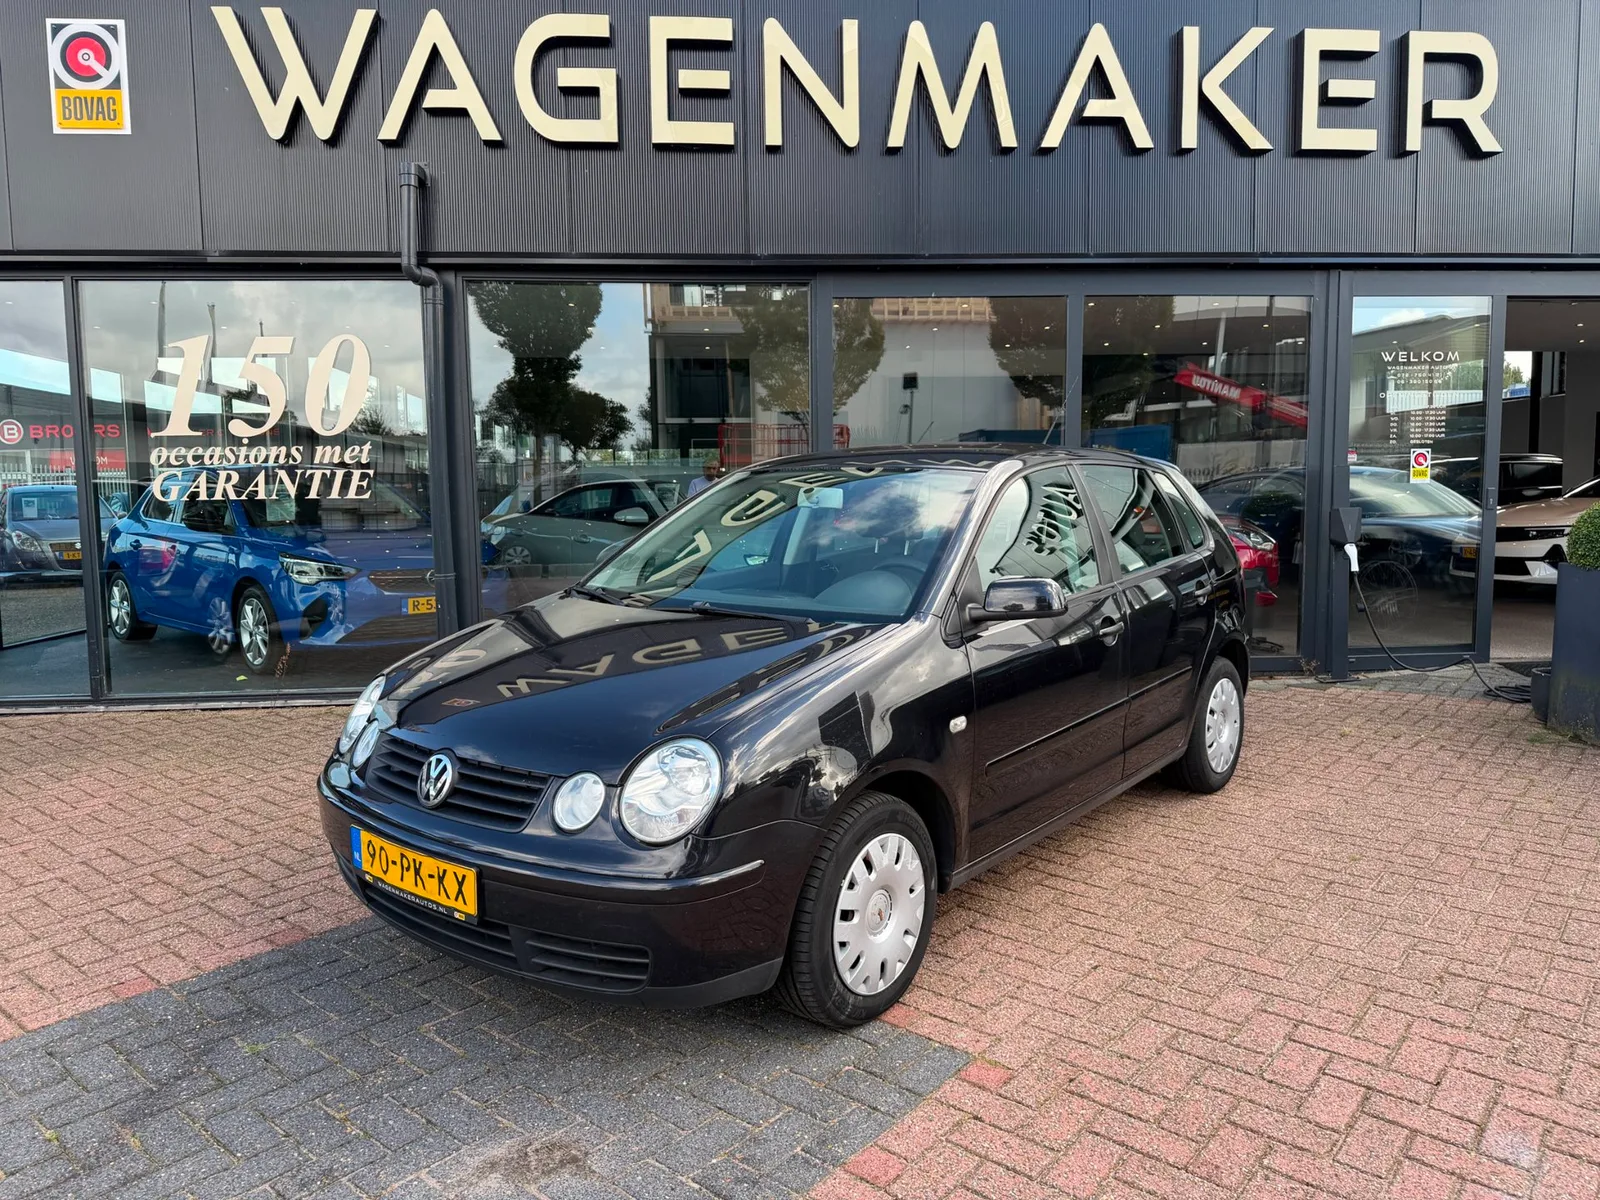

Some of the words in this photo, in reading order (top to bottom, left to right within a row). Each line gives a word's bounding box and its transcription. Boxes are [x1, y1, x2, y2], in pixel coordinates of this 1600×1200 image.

[211, 5, 1503, 154] WAGENMAKER
[61, 95, 118, 121] BOVAG
[1381, 351, 1460, 362] WELKOM
[150, 333, 371, 438] 150
[29, 424, 121, 438] BRORS
[150, 438, 303, 467] occasions
[313, 441, 372, 465] met
[152, 469, 374, 502] GARANTIE
[1412, 469, 1428, 478] BOVAG
[412, 599, 436, 611] R-5
[354, 850, 362, 863] NL
[366, 839, 468, 906] 90-PK-KX
[377, 880, 448, 914] WAGENMAKERAUTOS.NL
